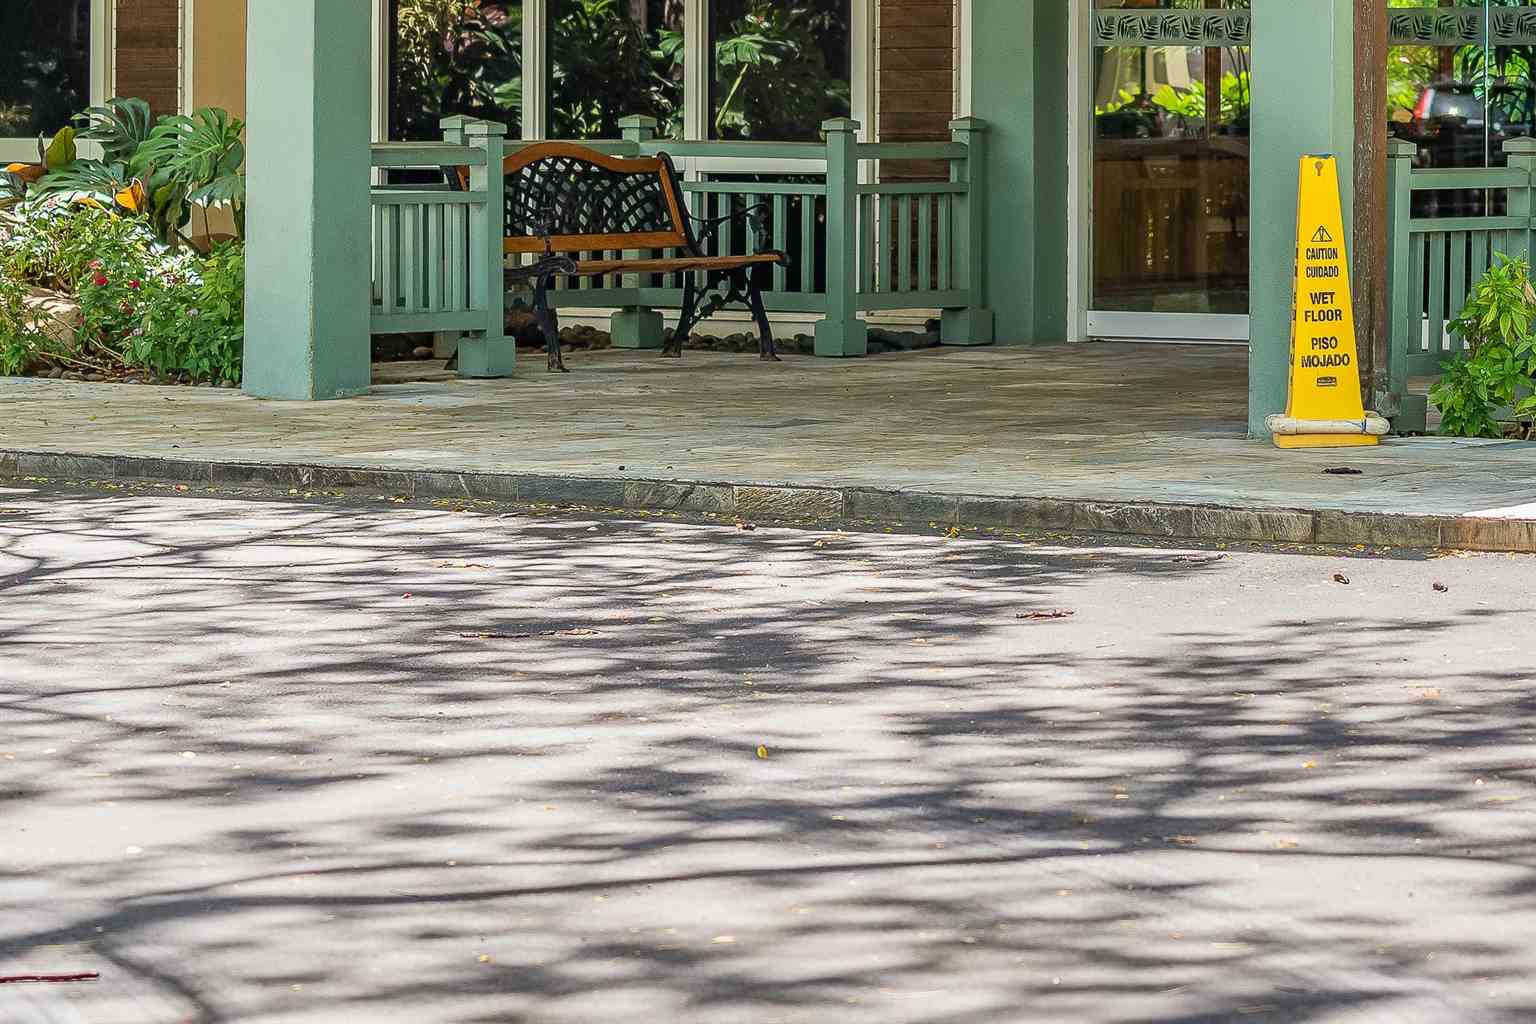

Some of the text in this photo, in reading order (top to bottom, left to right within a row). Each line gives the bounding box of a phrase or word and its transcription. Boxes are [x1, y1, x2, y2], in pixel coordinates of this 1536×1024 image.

[1306, 247, 1338, 260] CAUTION
[1306, 265, 1339, 278] CUIDADO
[1309, 291, 1336, 305] WET
[1304, 308, 1343, 323] FLOOR
[1311, 336, 1338, 350] PISO
[1301, 353, 1351, 368] MOJADO
